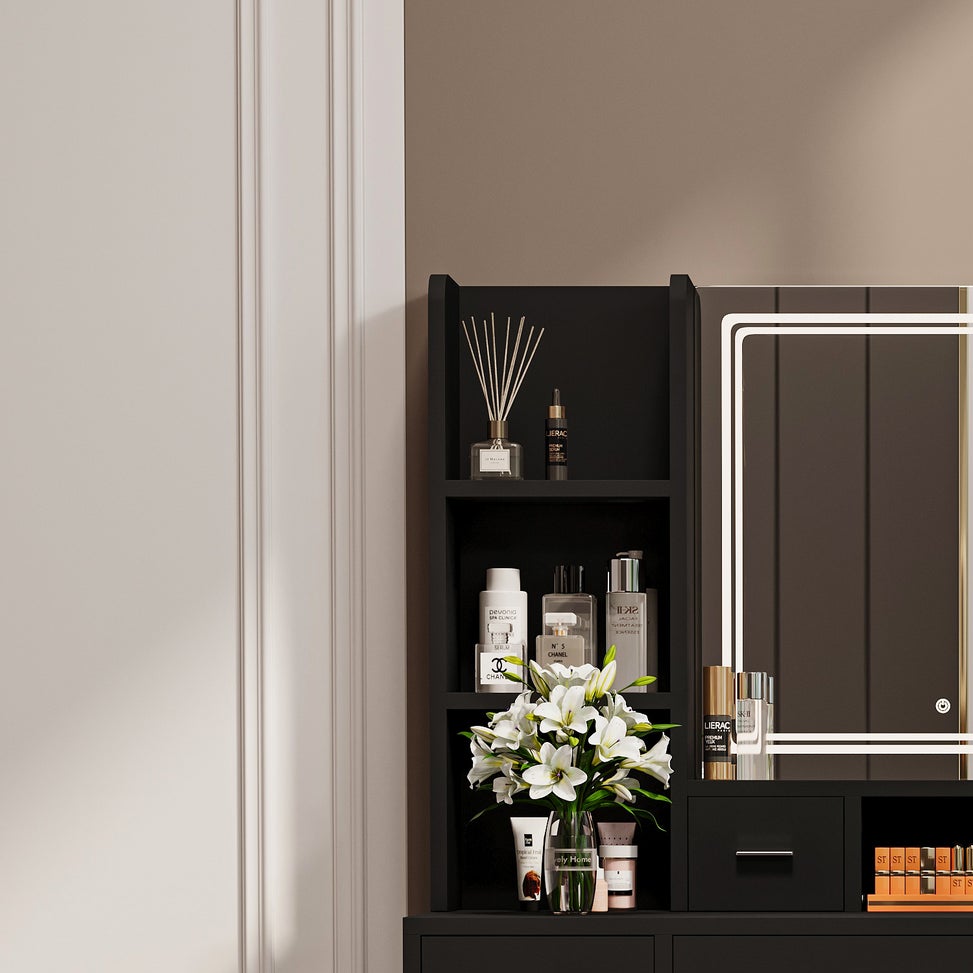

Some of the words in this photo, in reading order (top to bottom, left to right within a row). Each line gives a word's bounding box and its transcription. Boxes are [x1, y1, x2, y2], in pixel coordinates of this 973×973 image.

[704, 721, 731, 730] LIERAC
[569, 855, 592, 863] Home
[877, 855, 887, 864] ST
[892, 855, 902, 864] ST
[907, 855, 917, 864] ST
[938, 855, 947, 864] ST
[952, 879, 962, 887] ST
